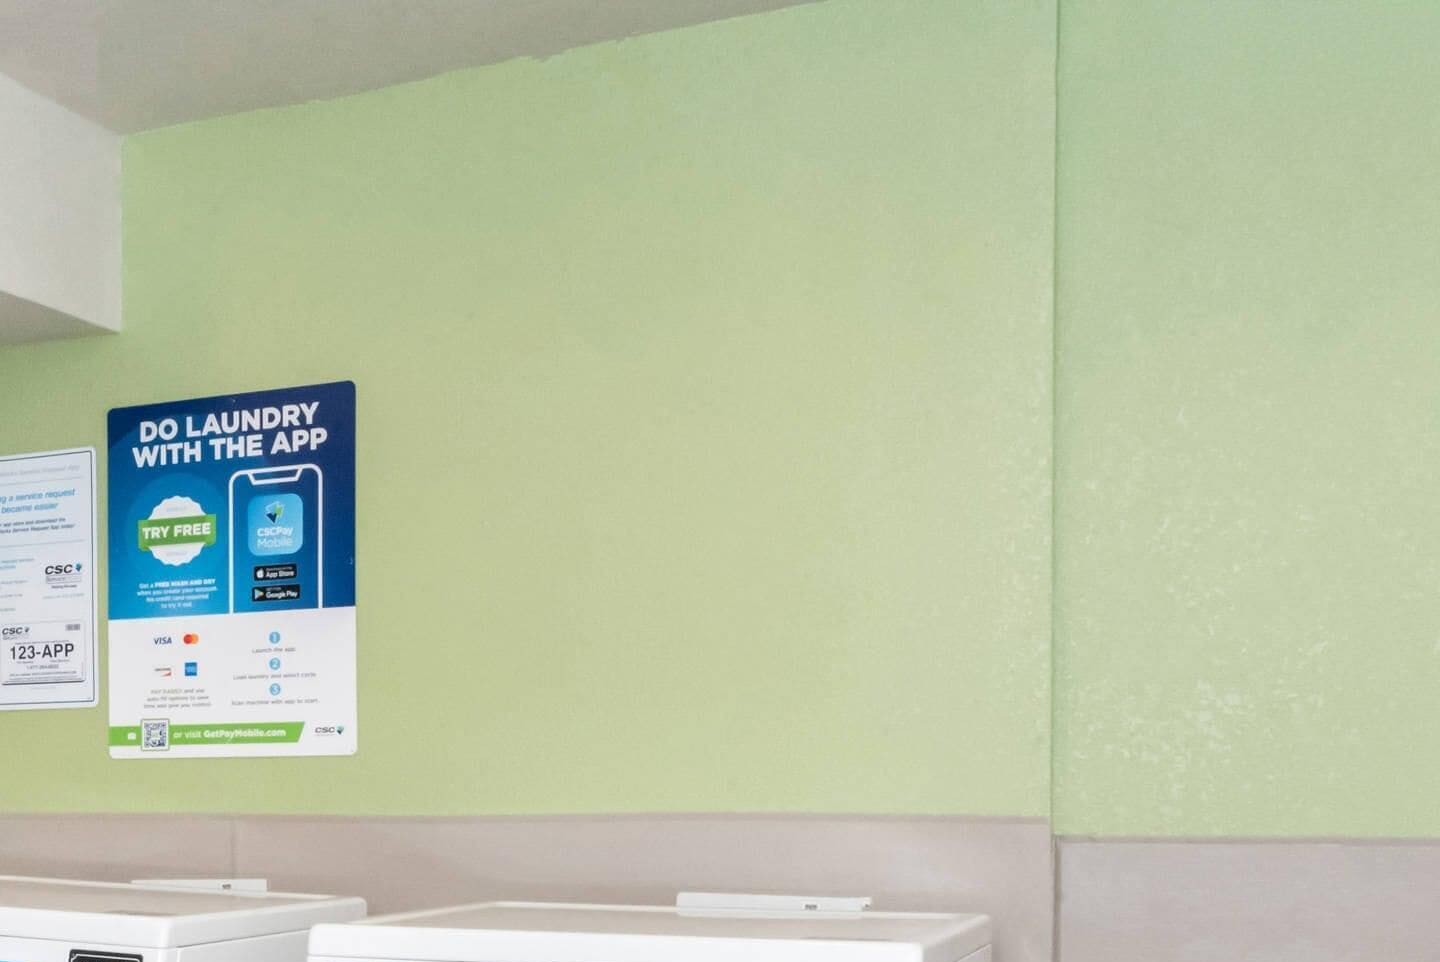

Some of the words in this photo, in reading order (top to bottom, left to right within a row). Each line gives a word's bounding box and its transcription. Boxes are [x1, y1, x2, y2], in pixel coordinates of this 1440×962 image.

[140, 419, 178, 442] DO
[186, 402, 319, 438] LAUNDRY
[132, 441, 201, 468] WITH
[210, 434, 263, 460] THE
[271, 428, 328, 454] APP
[16, 493, 43, 501] service
[45, 488, 76, 498] request
[142, 525, 170, 539] TRY
[174, 523, 211, 537] FREE
[257, 526, 293, 538] CSCPay
[257, 538, 293, 549] Mobile
[45, 564, 73, 575] CSC
[266, 591, 285, 599] Google
[287, 590, 298, 598] Play
[2, 627, 23, 635] CSC
[154, 637, 172, 645] VISA
[10, 643, 74, 660] 123-APP
[185, 730, 201, 739] visit
[203, 728, 287, 740] GetPayMobile.com
